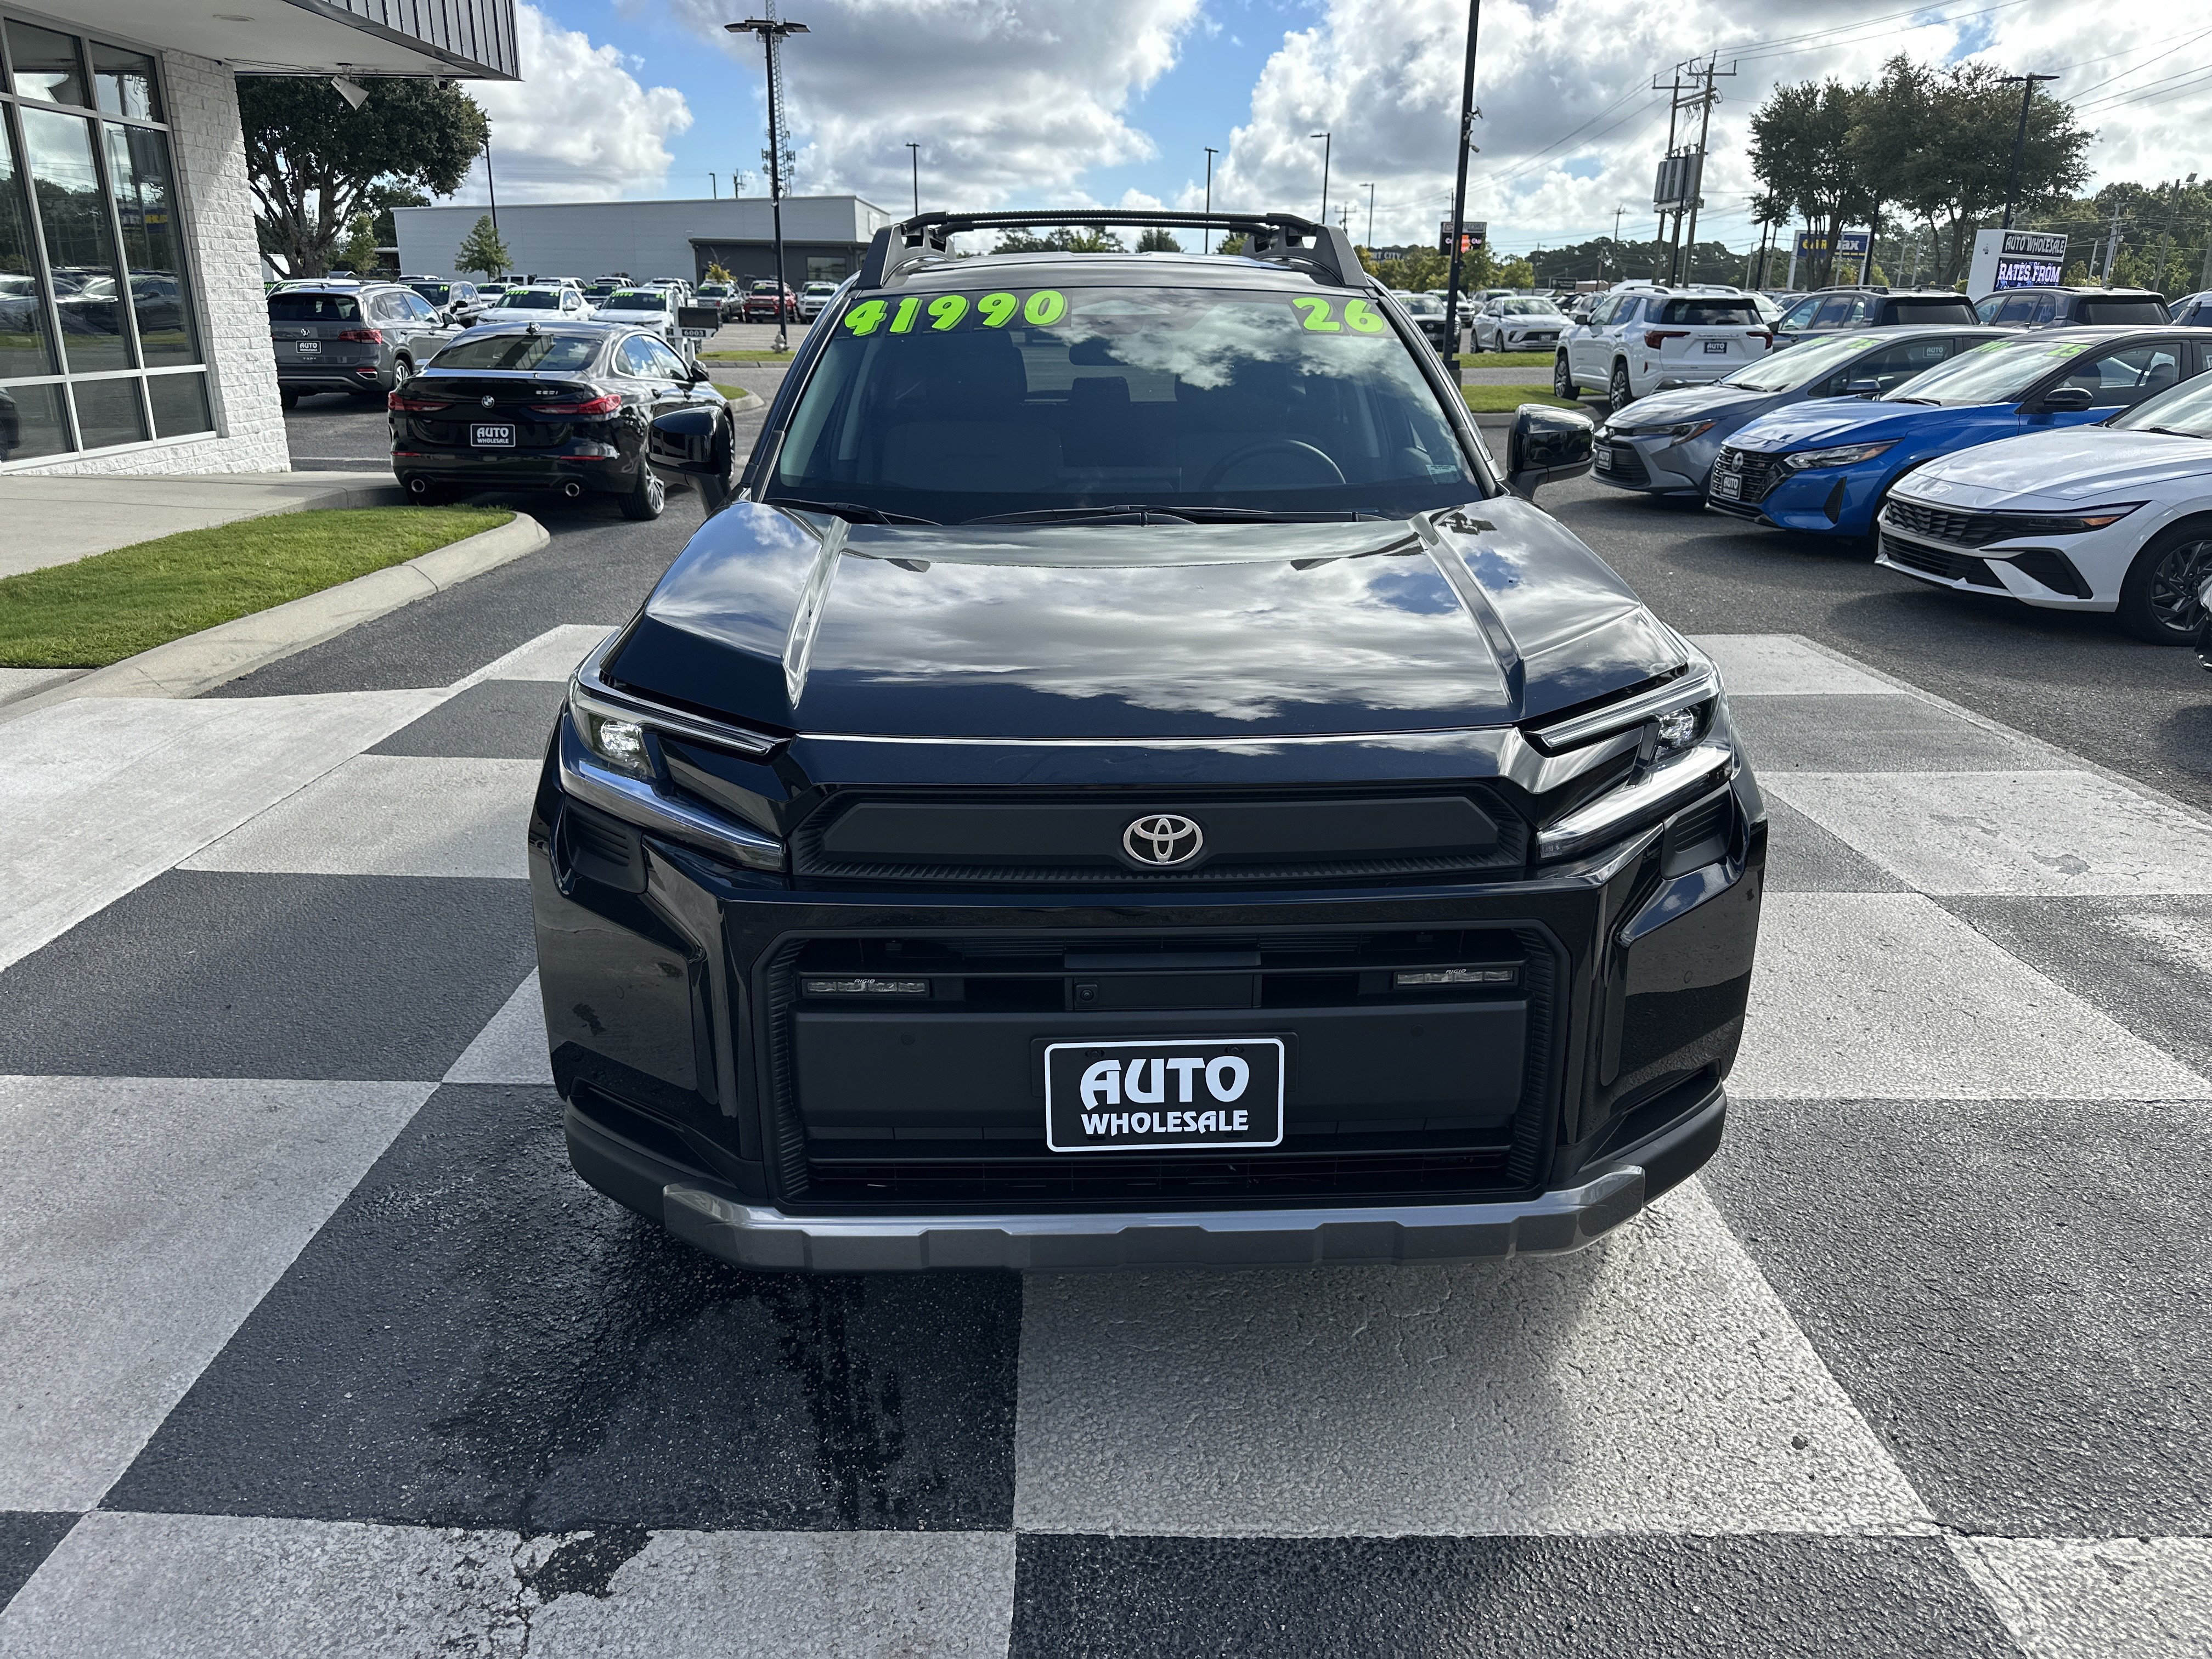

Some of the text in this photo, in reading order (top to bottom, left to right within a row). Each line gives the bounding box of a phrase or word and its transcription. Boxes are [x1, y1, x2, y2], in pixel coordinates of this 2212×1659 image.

[2005, 235, 2065, 255] AUTO WHOLESALE
[1997, 263, 2061, 283] RATES FROM
[844, 290, 1068, 337] 41990
[1292, 297, 1388, 335] 26
[2045, 343, 2090, 357] 25
[477, 427, 509, 438] AUTO
[1723, 476, 1739, 489] AUTO
[1080, 1055, 1250, 1111] AUTO
[1080, 1109, 1249, 1137] WHOLESALE
